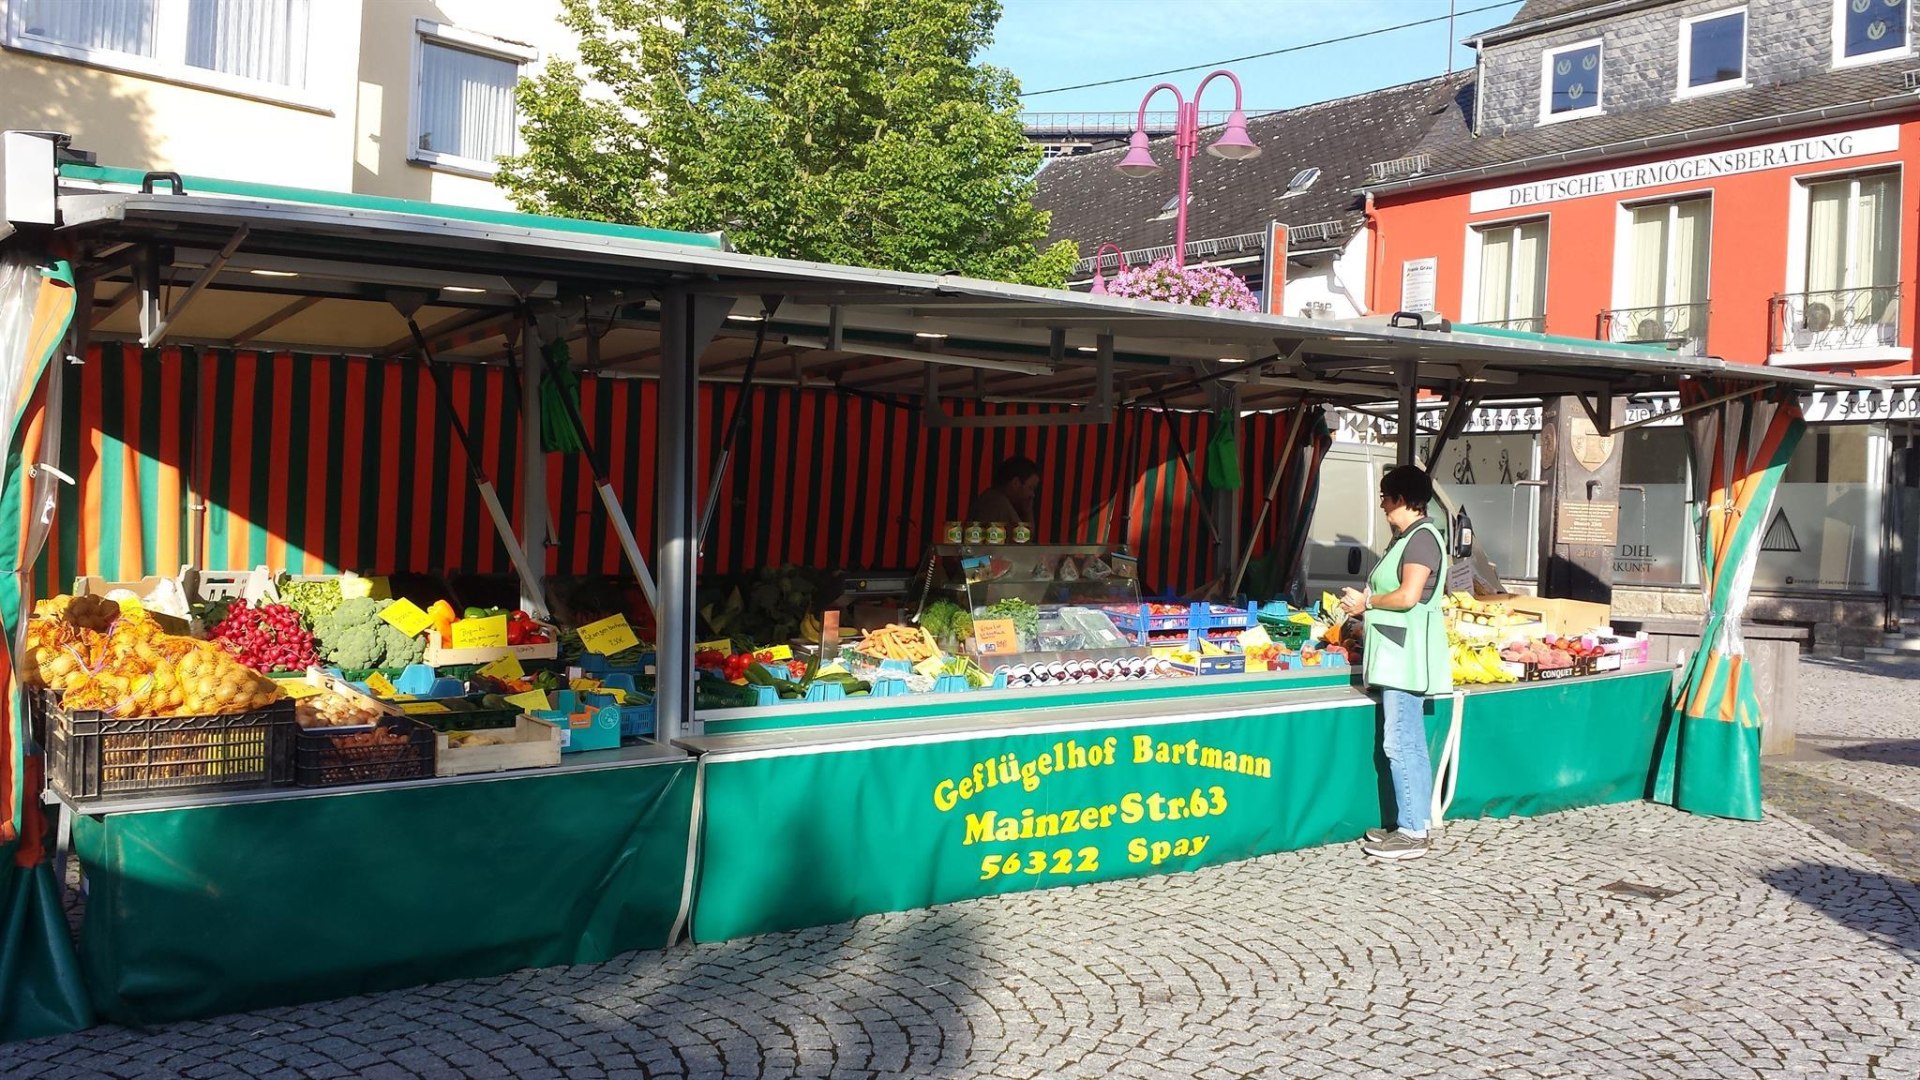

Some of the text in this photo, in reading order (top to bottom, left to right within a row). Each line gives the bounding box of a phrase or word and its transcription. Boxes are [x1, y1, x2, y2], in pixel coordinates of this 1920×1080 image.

[1509, 135, 1854, 206] DEUTSCHE VERMÖGENSBERATUNG
[1622, 544, 1653, 557] DIEL
[1541, 667, 1573, 679] CONQUET
[933, 734, 1272, 813] Geflügelhof Bartmann
[962, 804, 1117, 846] Mainzer
[979, 834, 1211, 882] 56322 Spay
